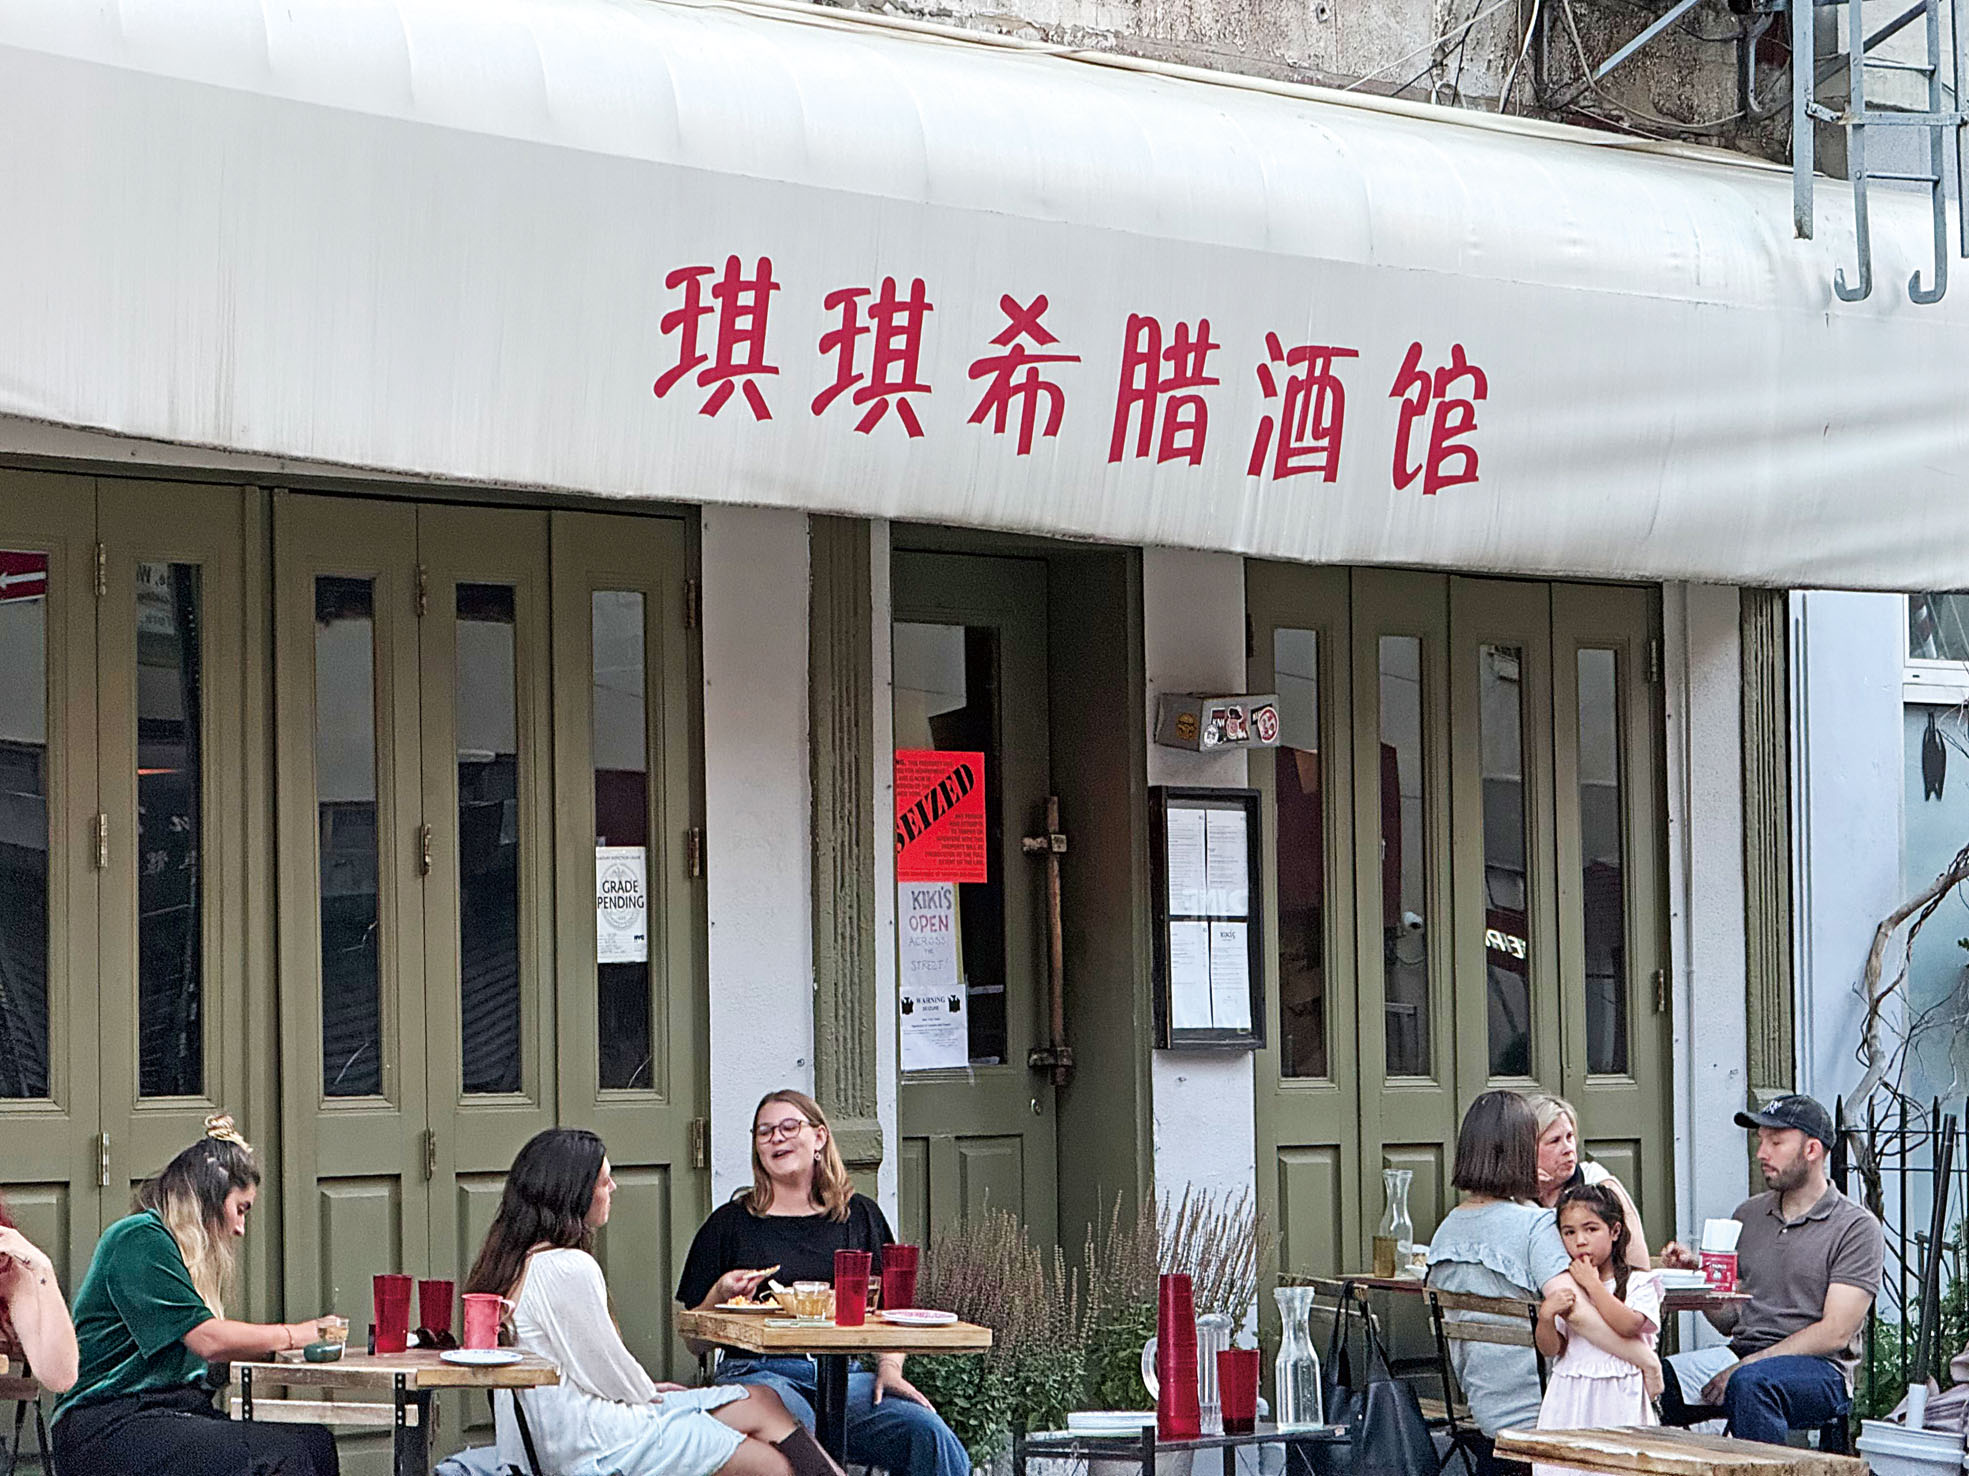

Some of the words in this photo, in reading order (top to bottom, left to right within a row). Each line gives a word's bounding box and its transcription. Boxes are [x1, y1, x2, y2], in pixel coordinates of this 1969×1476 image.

[653, 254, 1489, 496] 琪琪希腊酒馆
[602, 879, 639, 894] GRADE
[597, 894, 645, 909] PENDING
[911, 886, 952, 911] KIKI'S
[908, 914, 949, 933] OPEN
[908, 936, 946, 948] ACROSS
[915, 996, 946, 1004] WARNING
